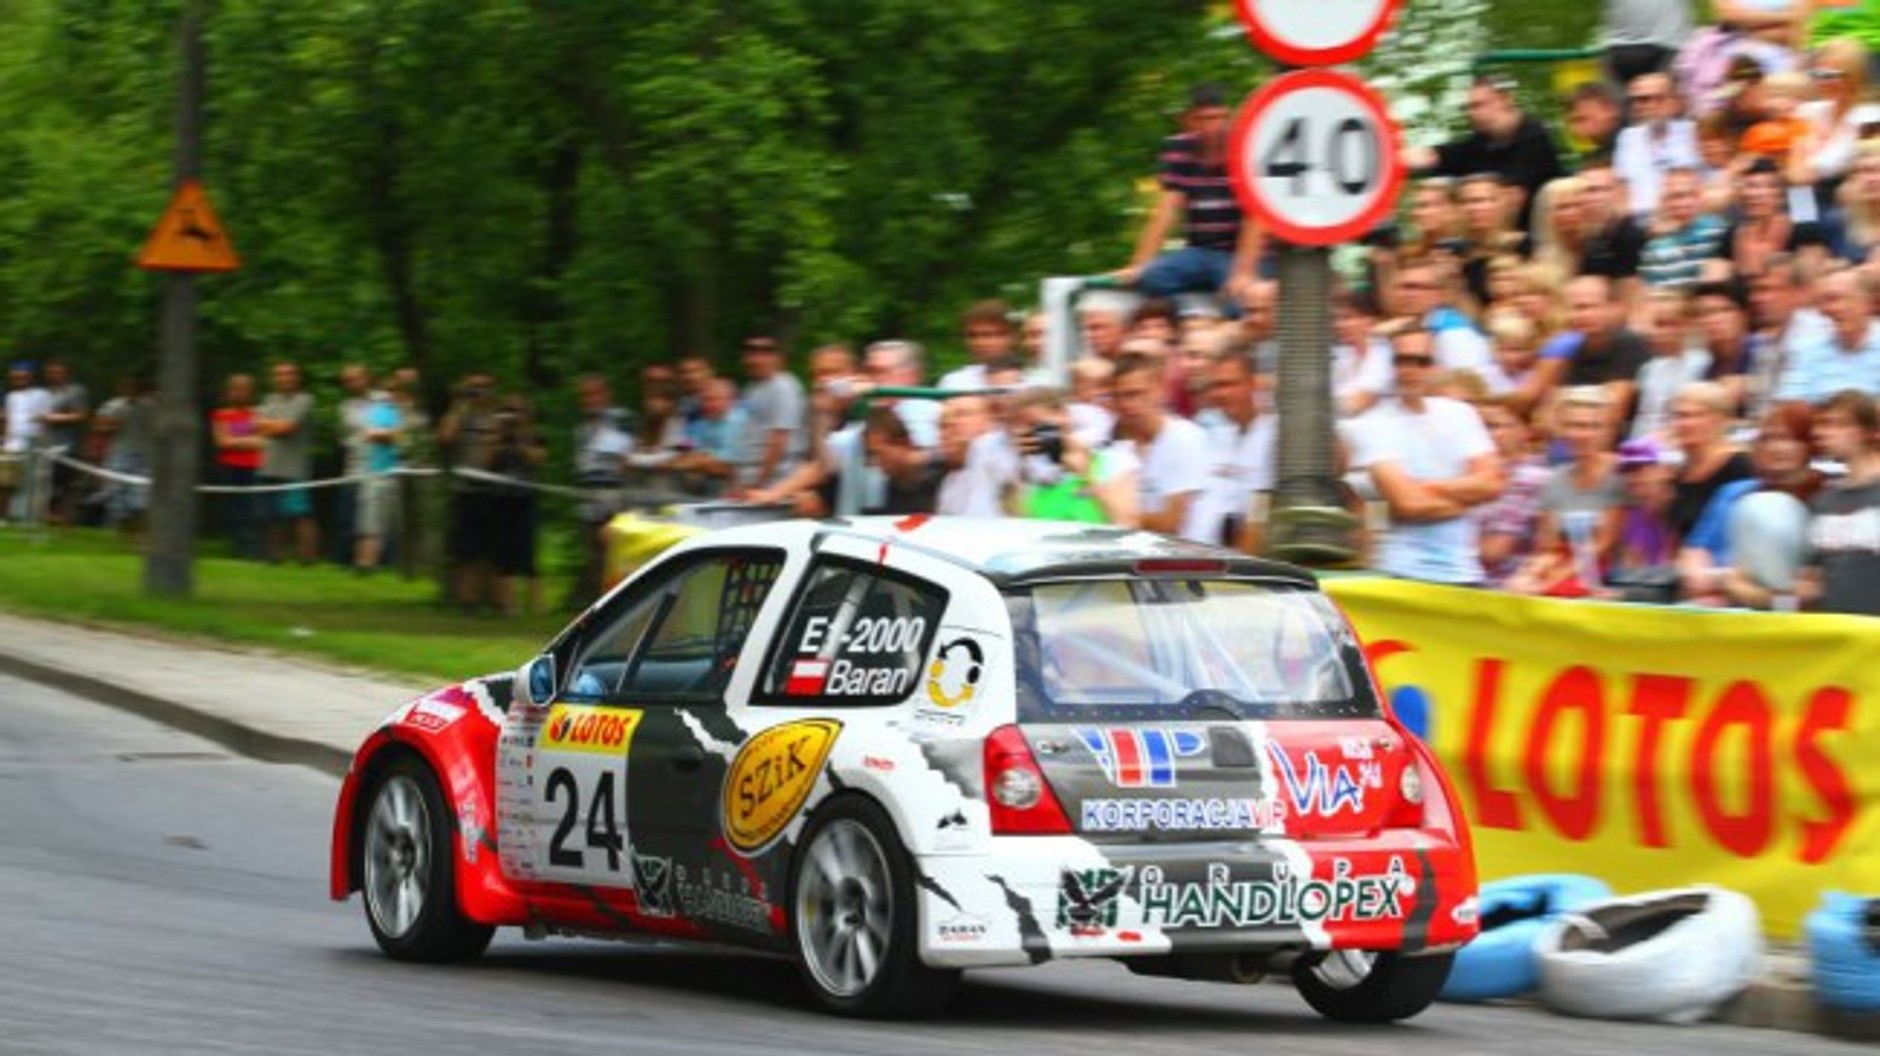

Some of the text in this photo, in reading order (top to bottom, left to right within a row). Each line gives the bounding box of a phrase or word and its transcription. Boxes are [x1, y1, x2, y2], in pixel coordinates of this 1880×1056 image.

[1257, 117, 1379, 196] 40
[825, 659, 909, 695] Baran
[570, 714, 632, 746] LOTOS
[1462, 656, 1858, 865] LOTOS
[544, 766, 623, 872] 24
[1141, 876, 1403, 926] HANDLOPEX
